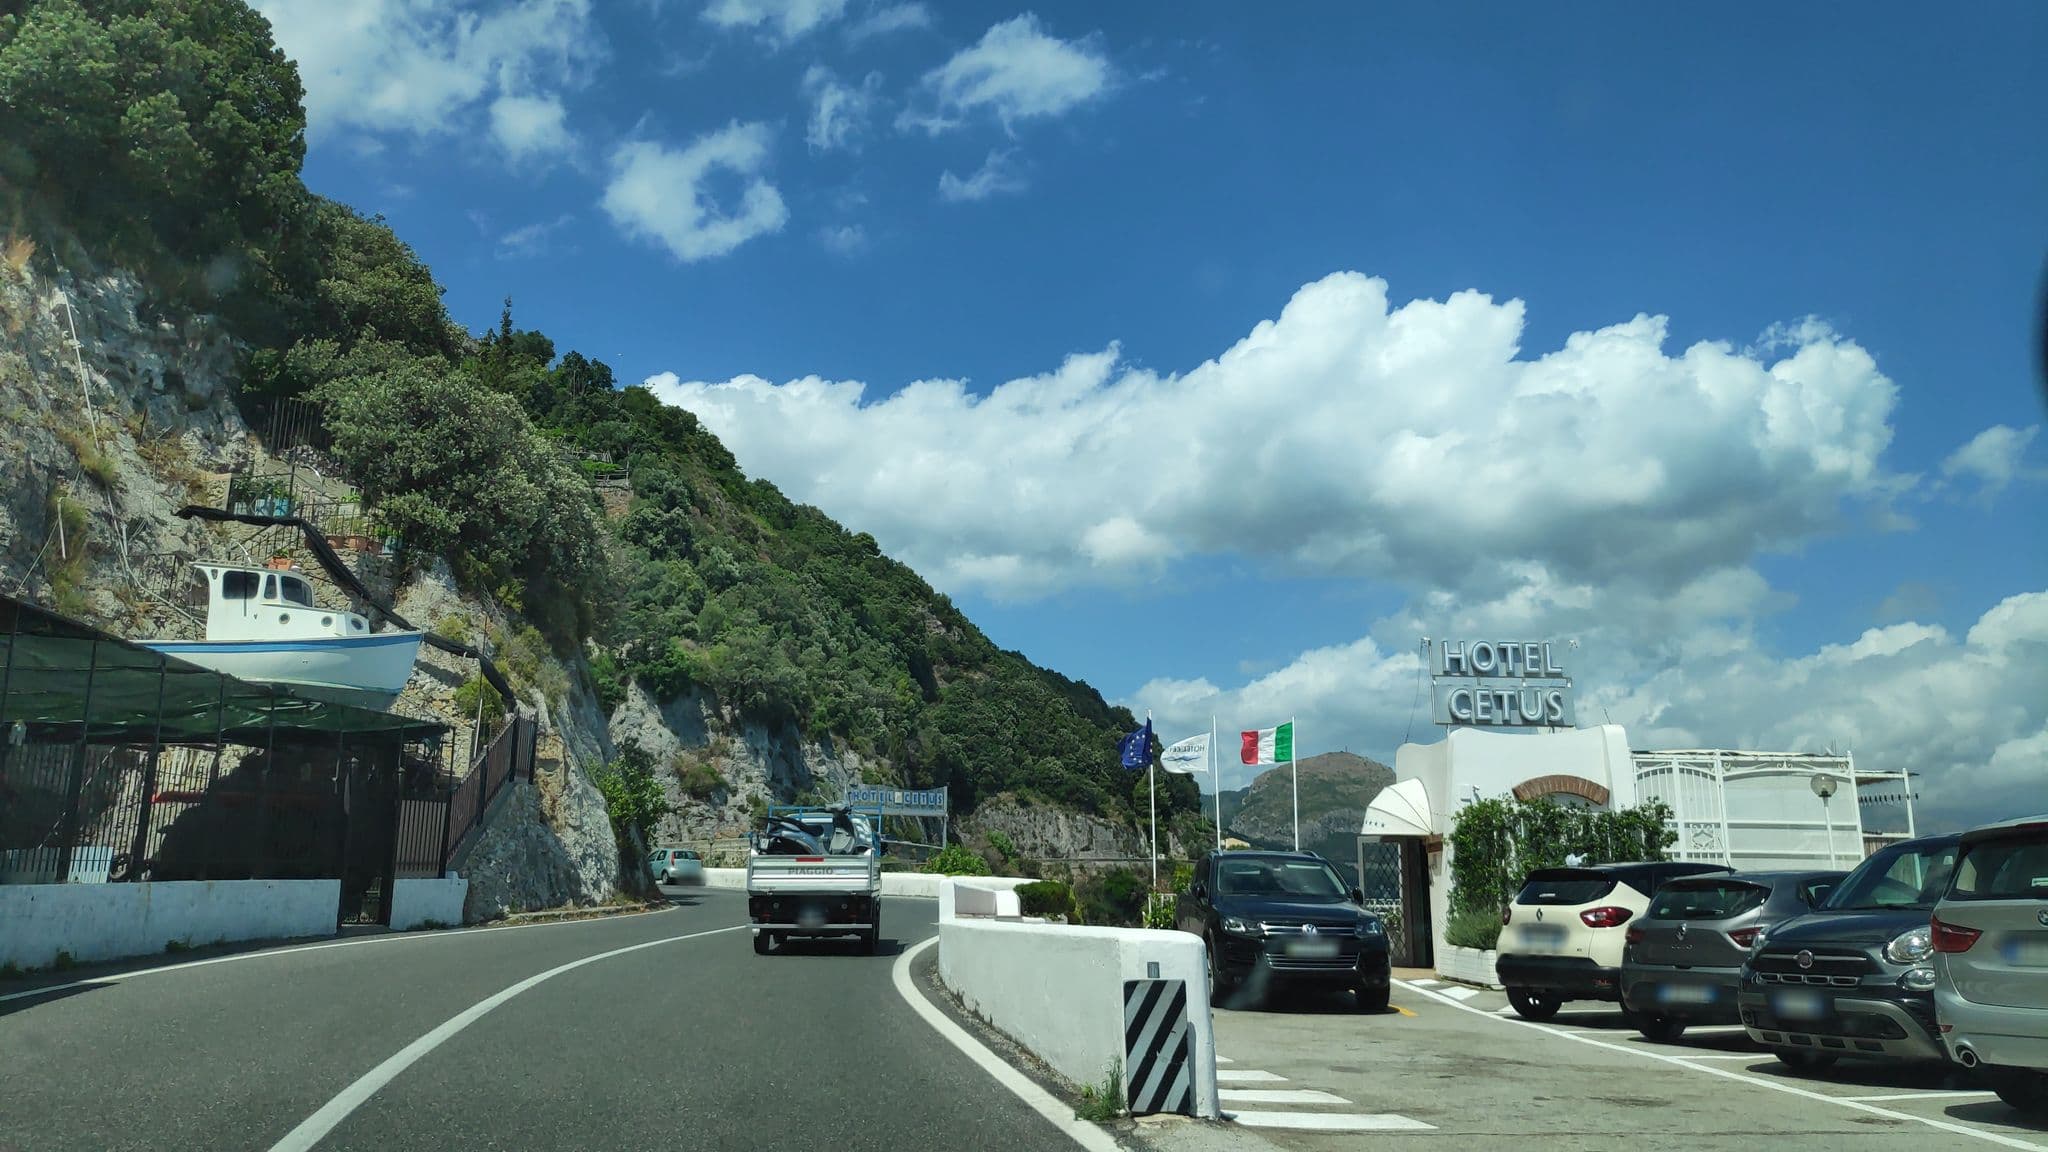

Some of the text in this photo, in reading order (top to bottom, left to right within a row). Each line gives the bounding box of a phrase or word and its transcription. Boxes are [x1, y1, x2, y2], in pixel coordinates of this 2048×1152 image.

[1442, 640, 1562, 675] HOTEL
[1449, 688, 1563, 722] CETUS
[852, 791, 943, 804] HOTEL CETUS
[787, 866, 833, 875] PIAGGIO
